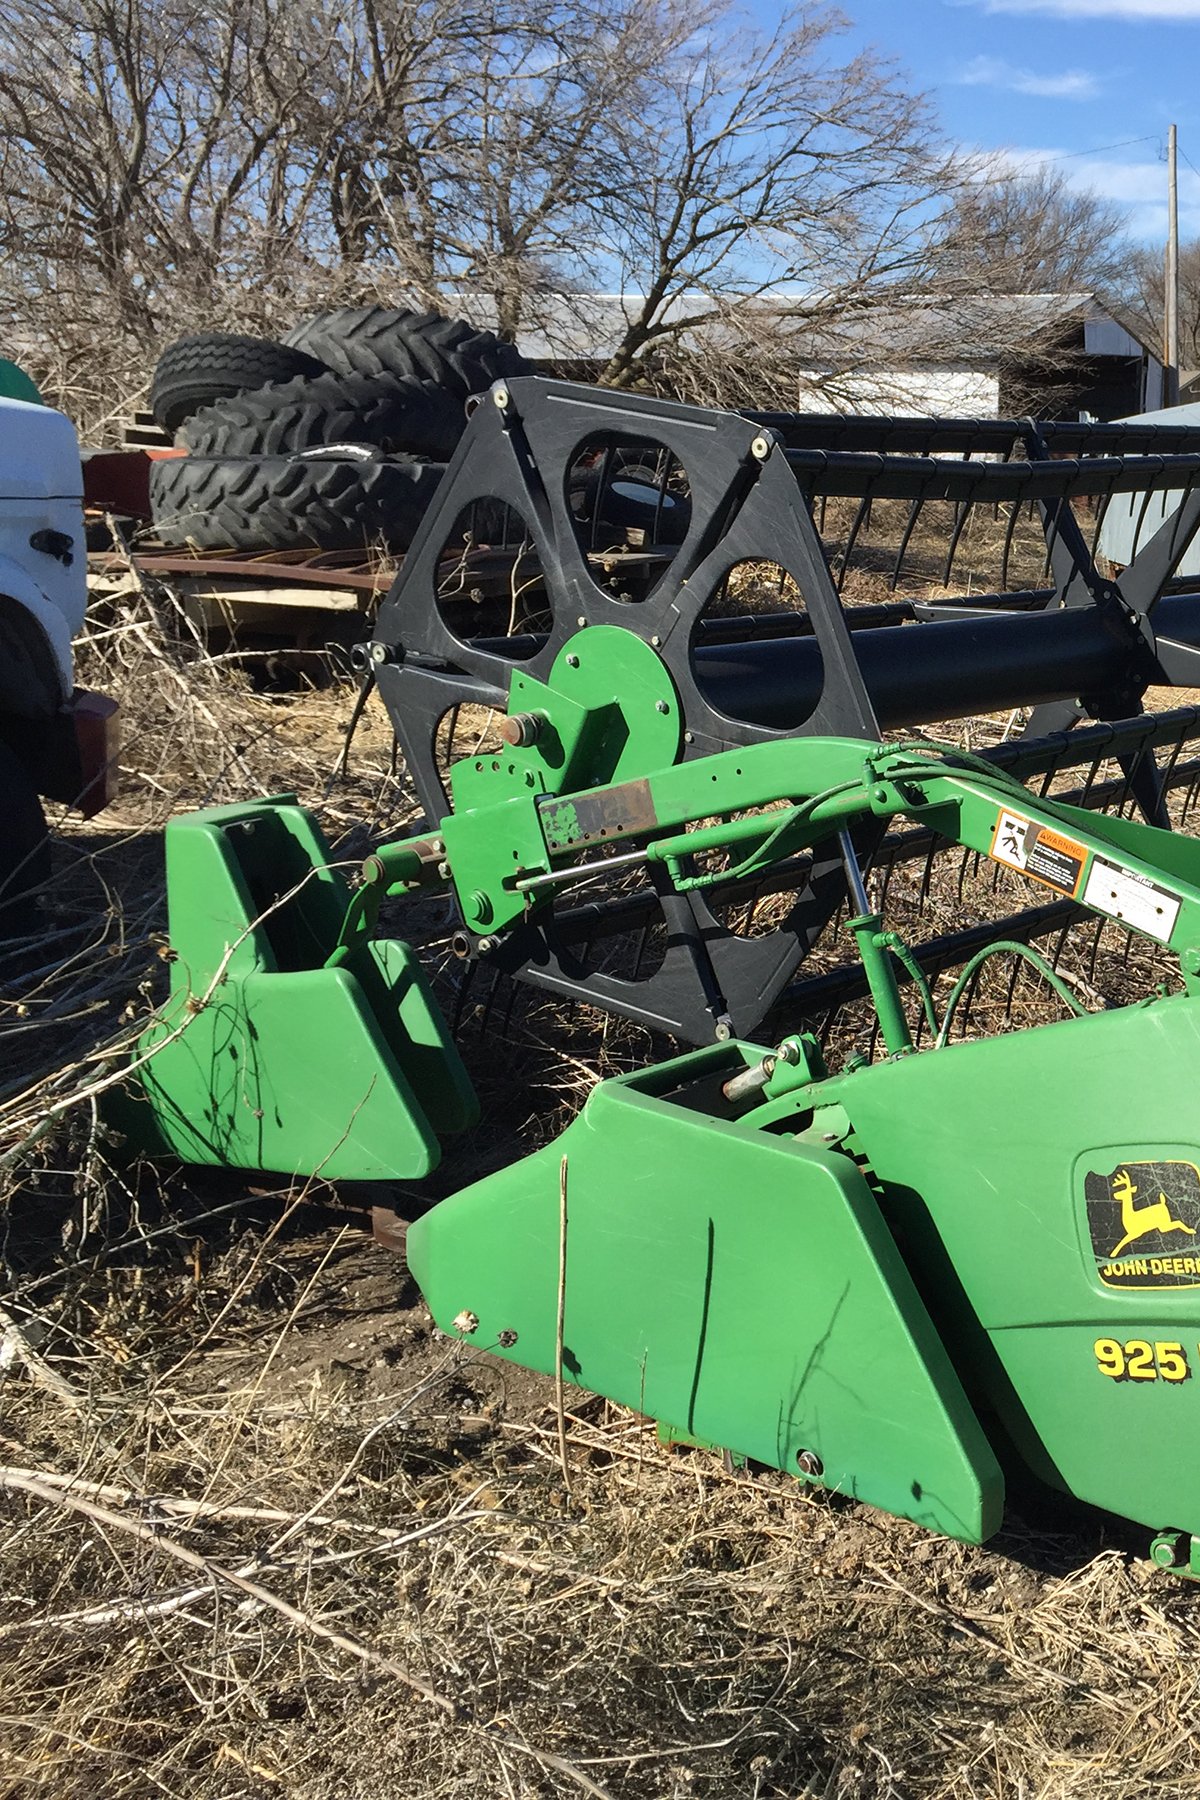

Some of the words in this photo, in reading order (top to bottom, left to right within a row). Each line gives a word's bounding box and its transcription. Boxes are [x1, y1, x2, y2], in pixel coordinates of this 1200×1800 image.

[1046, 834, 1082, 856] WARNING
[1103, 1260, 1148, 1277] JOHN
[1094, 1338, 1190, 1382] 925
